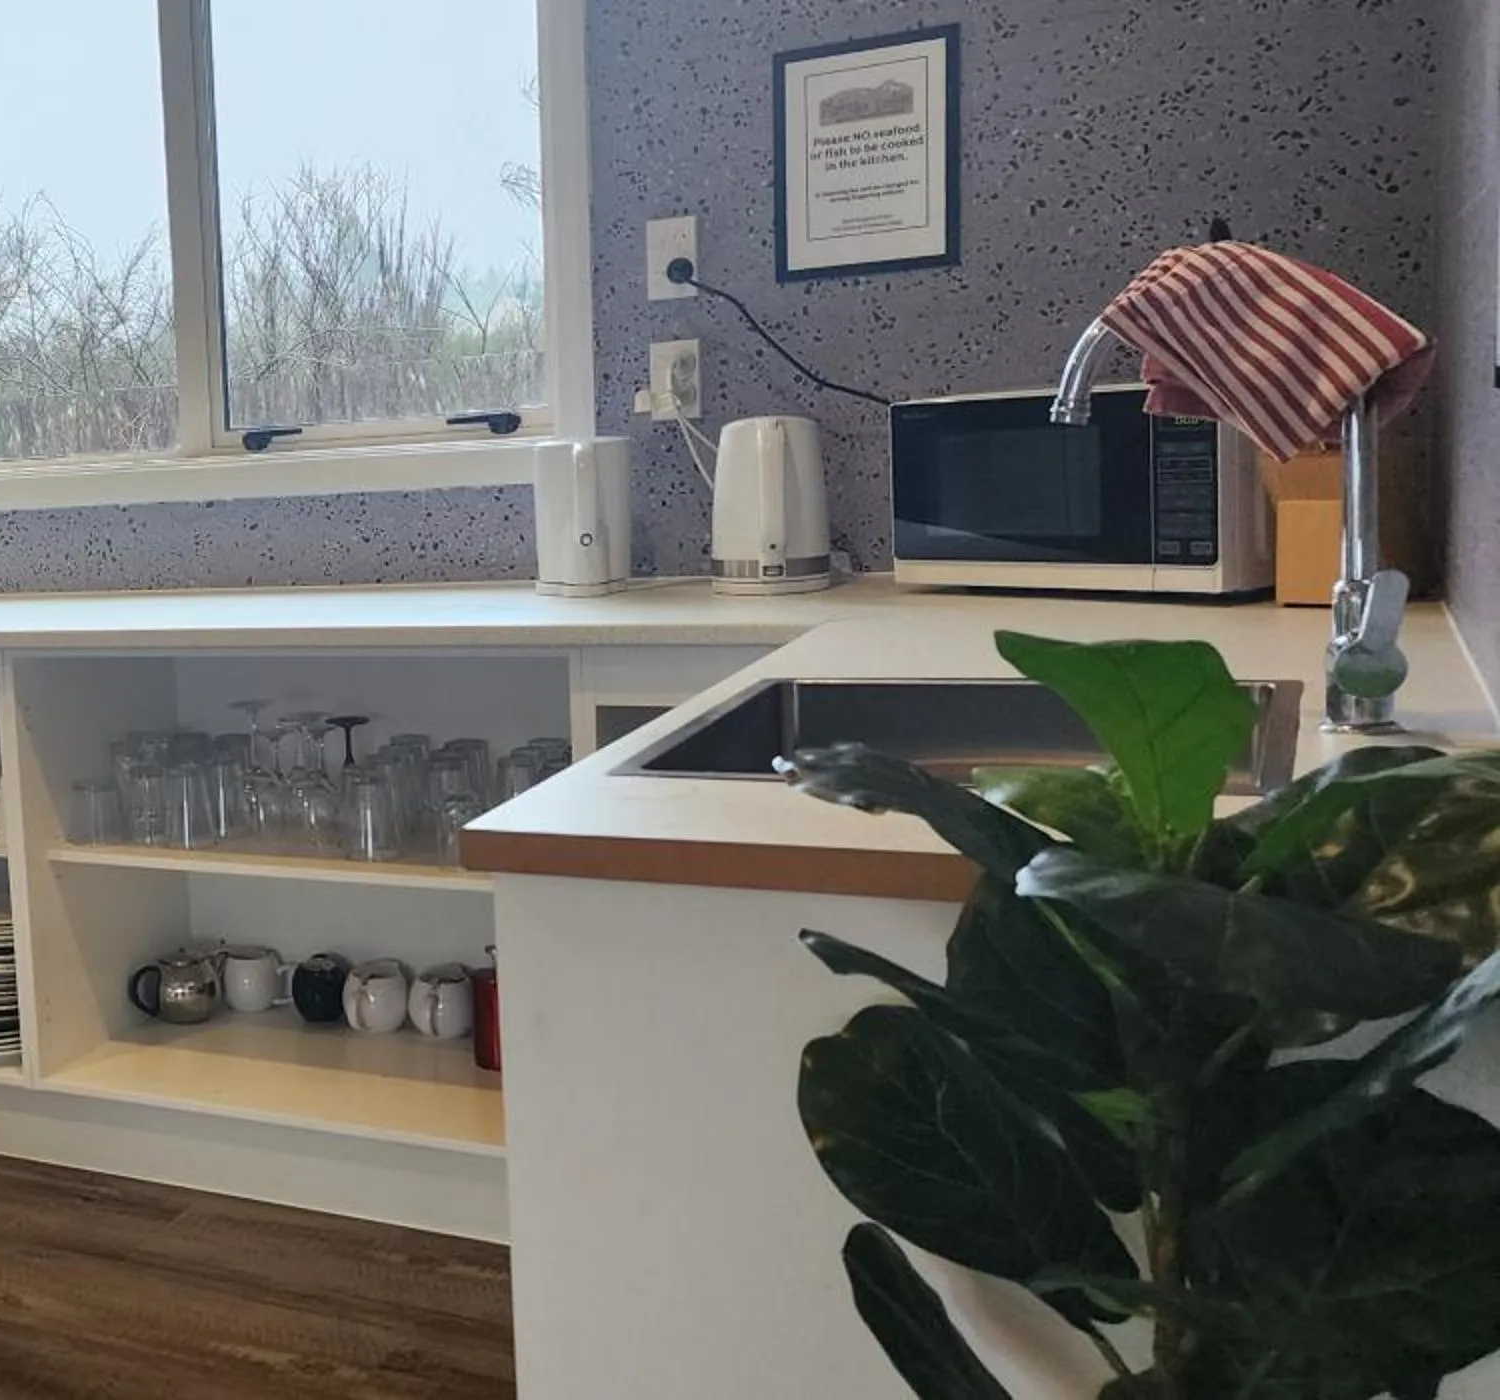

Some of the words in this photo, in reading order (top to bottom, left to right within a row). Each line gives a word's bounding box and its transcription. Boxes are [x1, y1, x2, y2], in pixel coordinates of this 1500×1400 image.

[813, 134, 851, 147] Please
[853, 130, 871, 141] NO
[873, 123, 920, 138] seafood
[810, 151, 821, 161] or
[824, 147, 847, 159] fish
[849, 145, 861, 155] to
[863, 142, 878, 153] be
[881, 135, 924, 151] cooked
[839, 158, 858, 169] the
